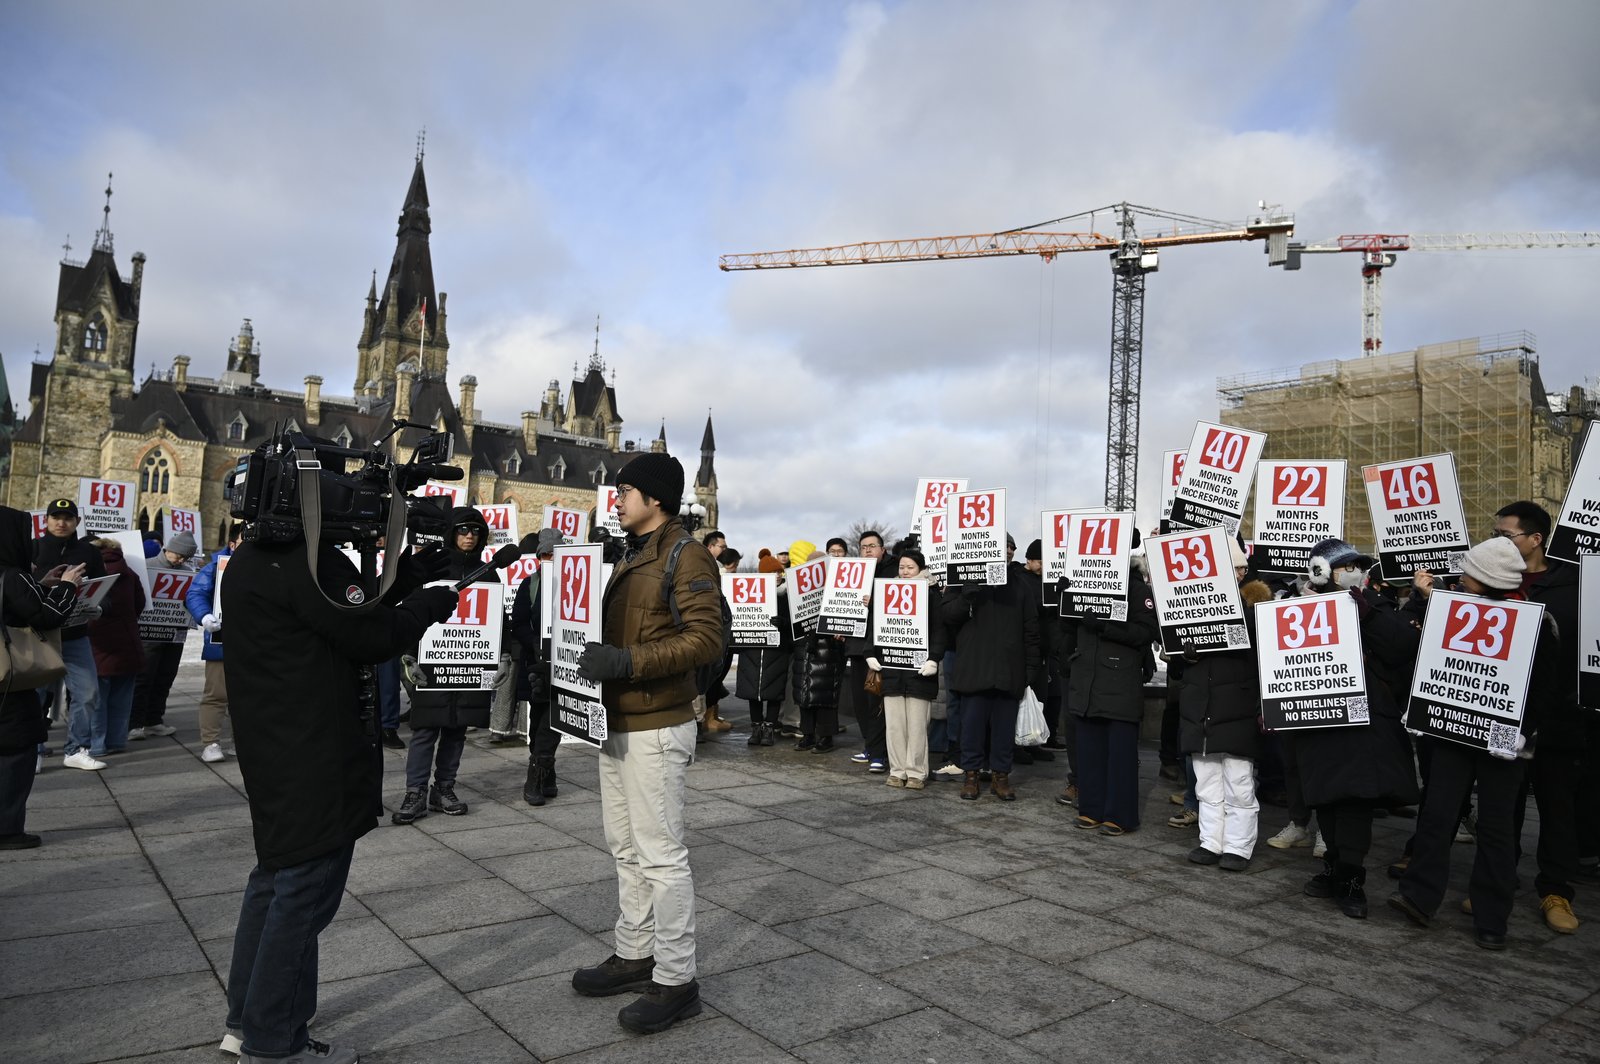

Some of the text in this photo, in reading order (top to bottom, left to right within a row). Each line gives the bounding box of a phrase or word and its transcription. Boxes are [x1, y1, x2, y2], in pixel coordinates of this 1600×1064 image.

[1205, 432, 1243, 470] 40
[1199, 469, 1233, 485] MONTHS
[1189, 478, 1239, 498] WAITING FOR
[1278, 467, 1321, 505] 22
[1388, 466, 1433, 508] 46
[95, 483, 121, 507] 19
[1181, 486, 1240, 510] IRCC RESPONSE
[962, 494, 991, 527] 53
[1184, 503, 1194, 512] NO
[1194, 505, 1224, 520] TIMELINE
[1184, 513, 1194, 521] NO
[1276, 510, 1318, 520] MONTHS
[1394, 510, 1438, 523] MONTHS
[174, 511, 194, 533] 35
[485, 509, 508, 529] 27
[555, 512, 577, 537] 19
[1266, 521, 1329, 532] WAITING FOR
[961, 531, 990, 540] MONTHS
[1386, 520, 1452, 536] WAITING FOR
[1085, 519, 1112, 555] 71
[1259, 532, 1280, 542] IRCC
[1382, 532, 1461, 548] IRCC RESPONSE
[1574, 533, 1592, 546] NO
[954, 540, 982, 550] WAITING
[983, 540, 998, 548] FOR
[950, 552, 965, 560] IRCC
[965, 550, 1002, 559] RESPONSE
[1168, 537, 1211, 580] 53
[1268, 549, 1279, 557] NO
[1395, 554, 1407, 562] NO
[956, 565, 965, 573] NO
[1080, 559, 1111, 568] MONTHS
[1271, 558, 1283, 567] NO
[1400, 561, 1450, 572] NO RESULTS
[800, 563, 824, 593] 30
[837, 563, 863, 589] 30
[1072, 570, 1119, 579] WAITING FOR
[155, 574, 189, 600] 27
[562, 556, 588, 622] 32
[735, 578, 763, 603] 34
[1070, 580, 1122, 590] RCC RESPONSE
[1174, 583, 1214, 596] MONTHS
[450, 588, 481, 624] 1
[797, 599, 821, 611] WAITING
[828, 599, 851, 607] WAITING
[888, 584, 914, 615] 28
[1072, 595, 1114, 605] NO TIMELINES
[1166, 593, 1228, 609] WAITING FOR
[1074, 604, 1083, 612] NO
[1163, 605, 1236, 621] IRCC RESPONSE
[886, 618, 912, 626] MONTHS
[1282, 601, 1333, 649] 34
[442, 629, 481, 638] MONTHS
[562, 629, 586, 646] MONTHS
[881, 626, 905, 634] WAITING
[1176, 627, 1187, 637] NO
[1449, 603, 1508, 657] 23
[432, 639, 490, 649] WAITING FOR
[877, 635, 923, 645] IRCC RESPONSE
[1194, 634, 1228, 645] RESULTS
[425, 650, 494, 660] IRCC RESPONSE
[1284, 651, 1334, 666] MONTHS
[433, 666, 445, 674] NO
[554, 665, 566, 680] IRCC
[1273, 663, 1348, 680] WAITING FOR
[1444, 657, 1498, 677] MONTHS
[447, 675, 481, 683] RESULTS
[1268, 676, 1357, 693] IRCC RESPONSE
[1430, 668, 1510, 696] WAITING FOR
[558, 693, 565, 706] NO
[1280, 697, 1347, 711] NO TIMELINES
[1419, 682, 1515, 713] IRCC RESPONSE
[560, 709, 588, 731] NO RESULTS
[1285, 709, 1343, 721] NO RESULTS
[1428, 705, 1491, 729] NO TIMELINE
[1430, 718, 1490, 741] NO RESULTS
